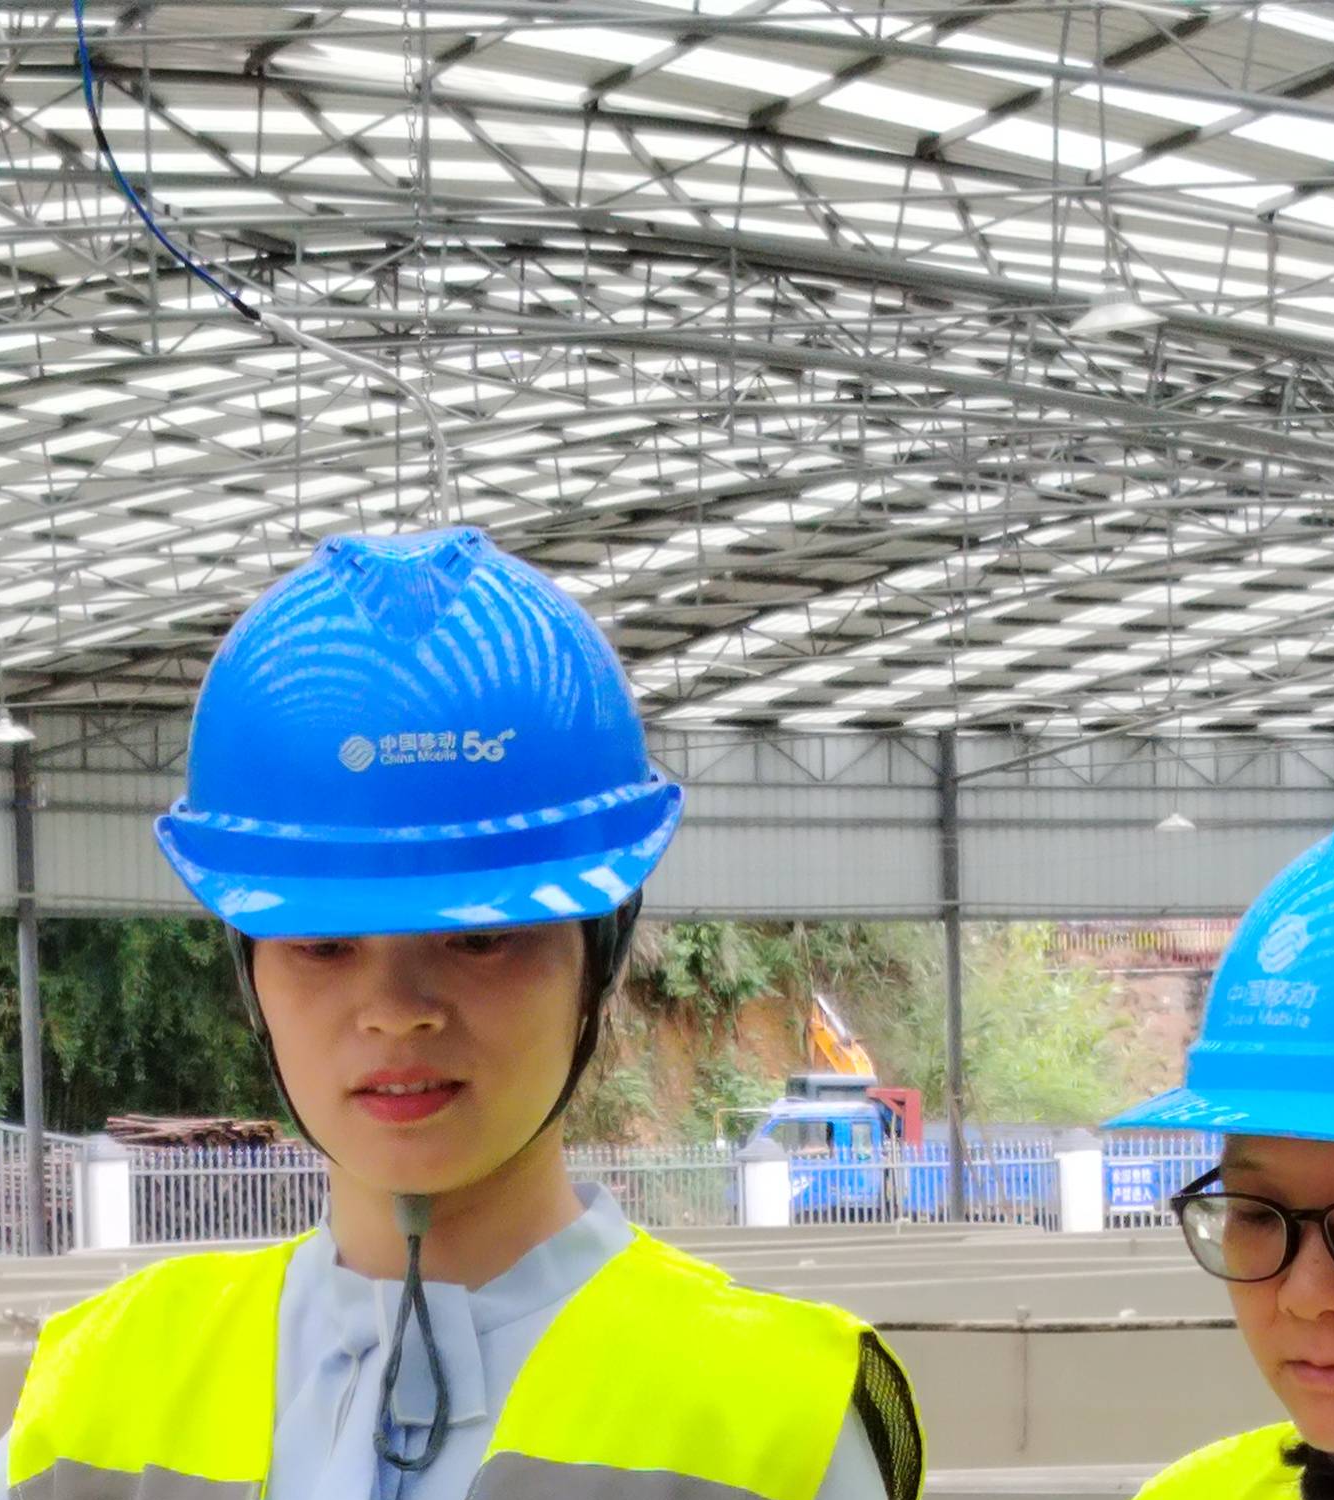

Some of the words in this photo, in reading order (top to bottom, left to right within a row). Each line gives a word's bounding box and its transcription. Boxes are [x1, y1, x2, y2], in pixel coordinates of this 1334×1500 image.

[379, 731, 457, 752] 中国移动
[379, 753, 415, 765] China
[418, 750, 457, 763] Mobile
